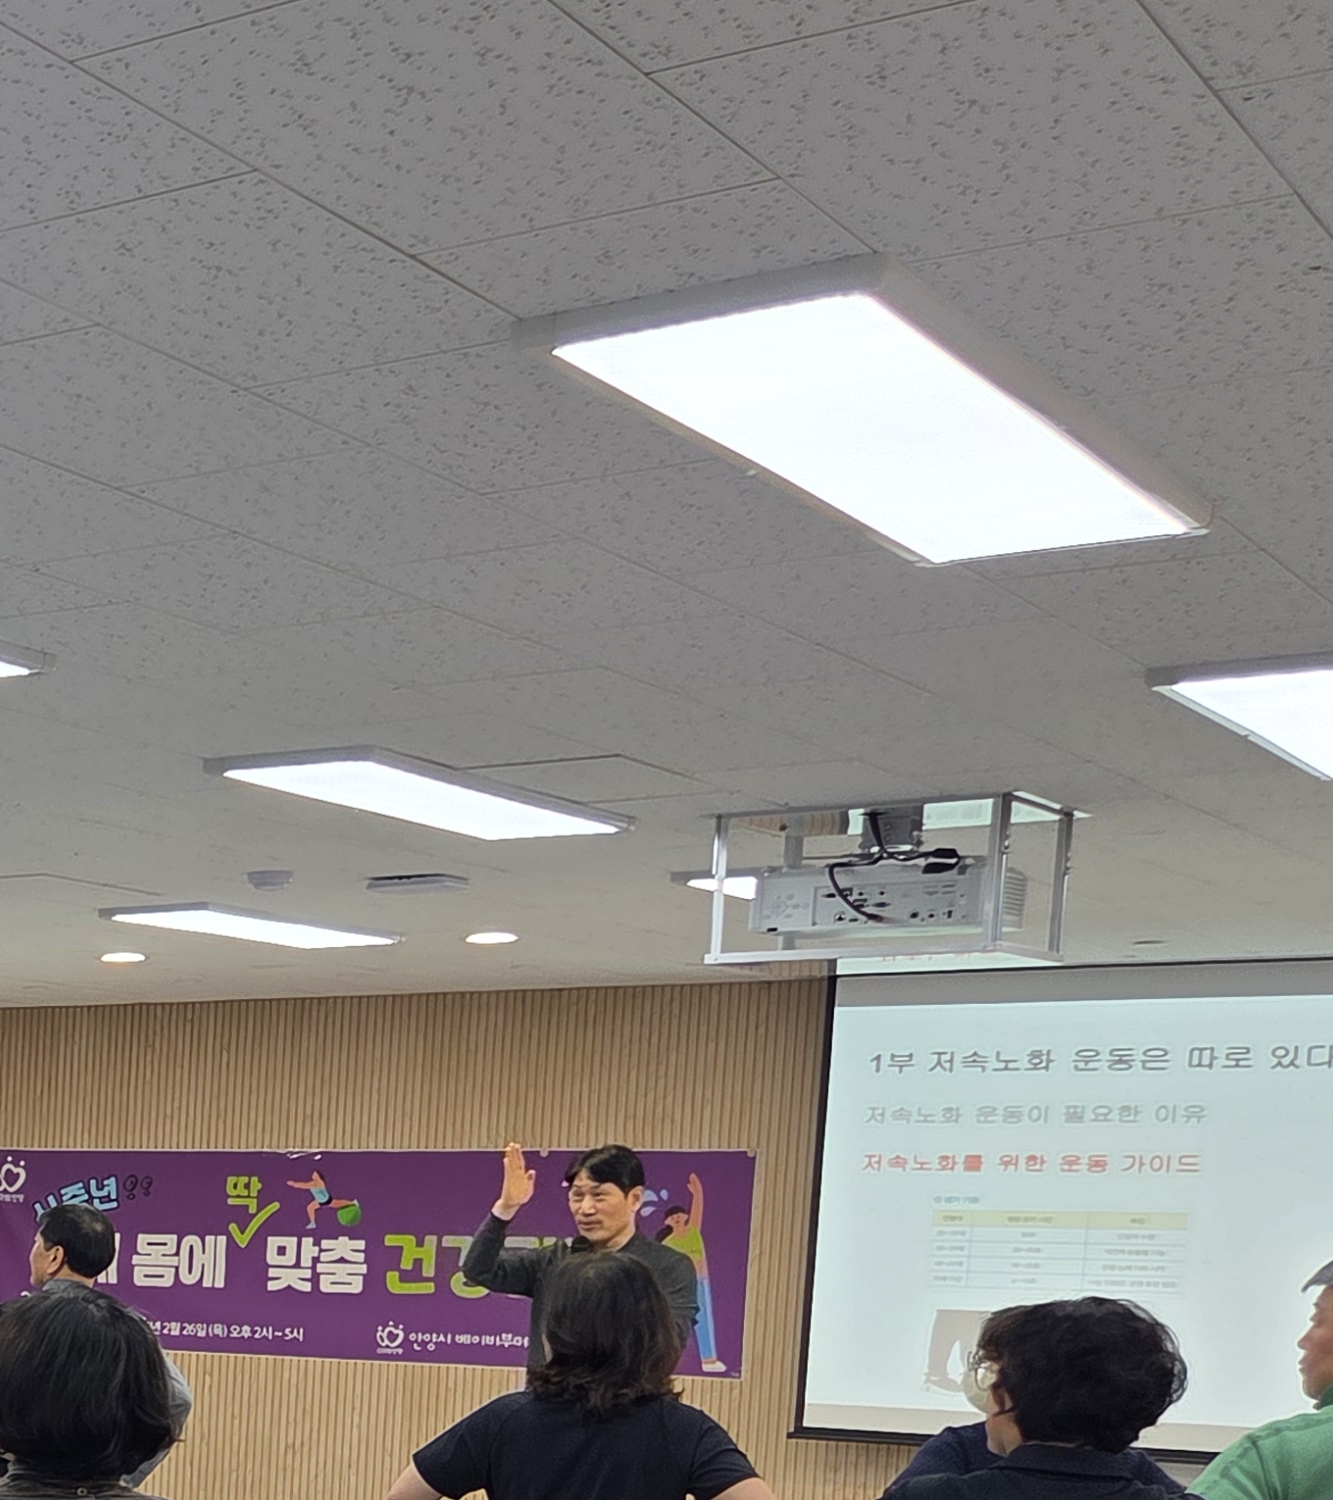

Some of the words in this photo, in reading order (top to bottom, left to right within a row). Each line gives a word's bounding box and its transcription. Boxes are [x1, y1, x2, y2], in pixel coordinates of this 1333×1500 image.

[868, 1051, 917, 1074] 1부
[928, 1048, 1056, 1074] 저속노화
[1070, 1047, 1172, 1072] 운동은
[1187, 1045, 1255, 1071] 따로
[1269, 1044, 1333, 1071] 있다
[864, 1104, 963, 1126] 저속노화
[974, 1103, 1051, 1125] 운동이
[1062, 1103, 1143, 1125] 필요한
[1154, 1103, 1209, 1125] 이유
[861, 1153, 984, 1174] 저속노화를
[996, 1153, 1048, 1174] 위한
[1058, 1153, 1110, 1174] 운동
[1120, 1153, 1202, 1174] 가이드
[226, 1176, 262, 1213] 딱
[131, 1233, 228, 1289] 몸에
[265, 1236, 368, 1295] 맞춤
[162, 1322, 181, 1336] 2월
[229, 1325, 252, 1340] 오후
[408, 1332, 452, 1351] 안양시
